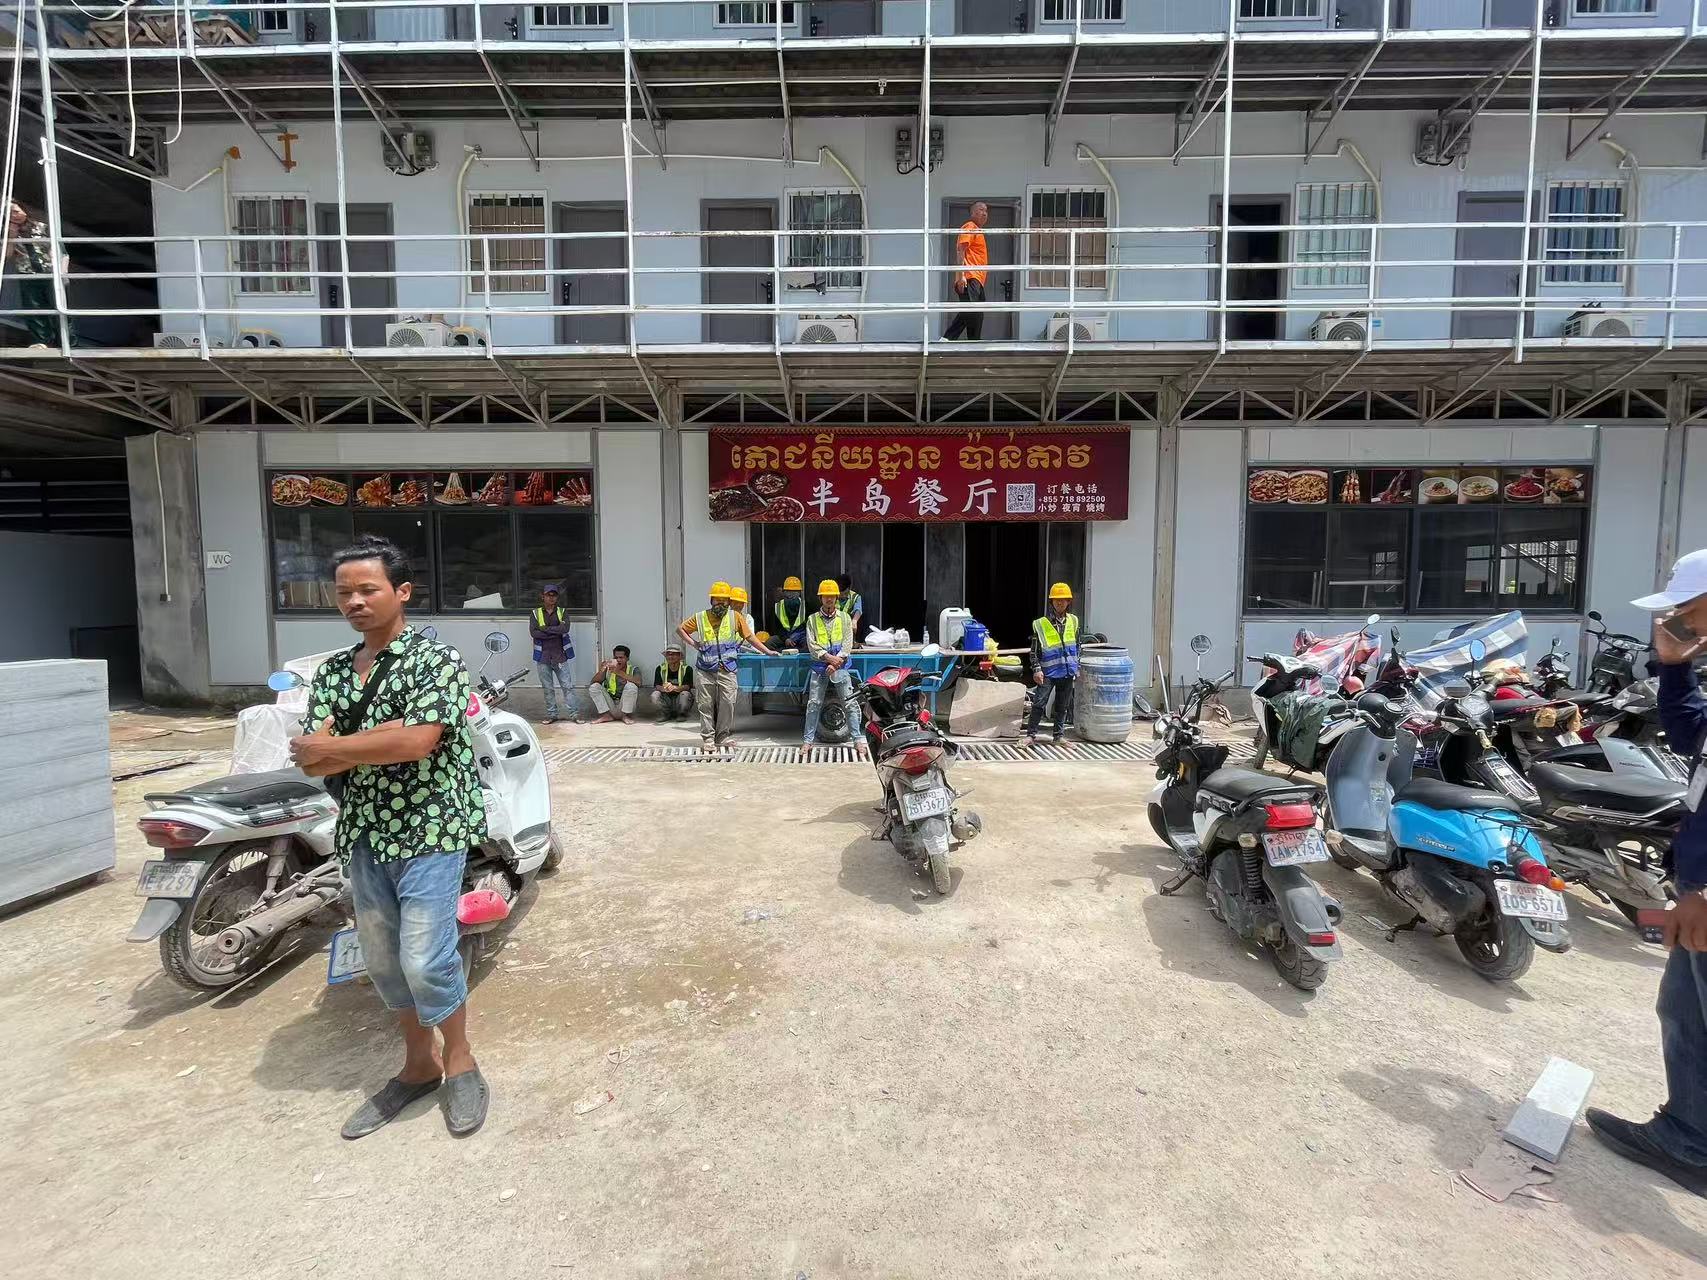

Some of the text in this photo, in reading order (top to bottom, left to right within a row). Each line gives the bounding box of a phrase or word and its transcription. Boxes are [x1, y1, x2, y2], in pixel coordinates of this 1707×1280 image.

[1047, 483, 1098, 494] 订餐电话
[807, 477, 997, 516] 半岛餐厅
[1060, 495, 1075, 503] 718
[1076, 495, 1106, 503] 892500
[1086, 503, 1105, 512] 烧烤
[212, 554, 231, 564] WC
